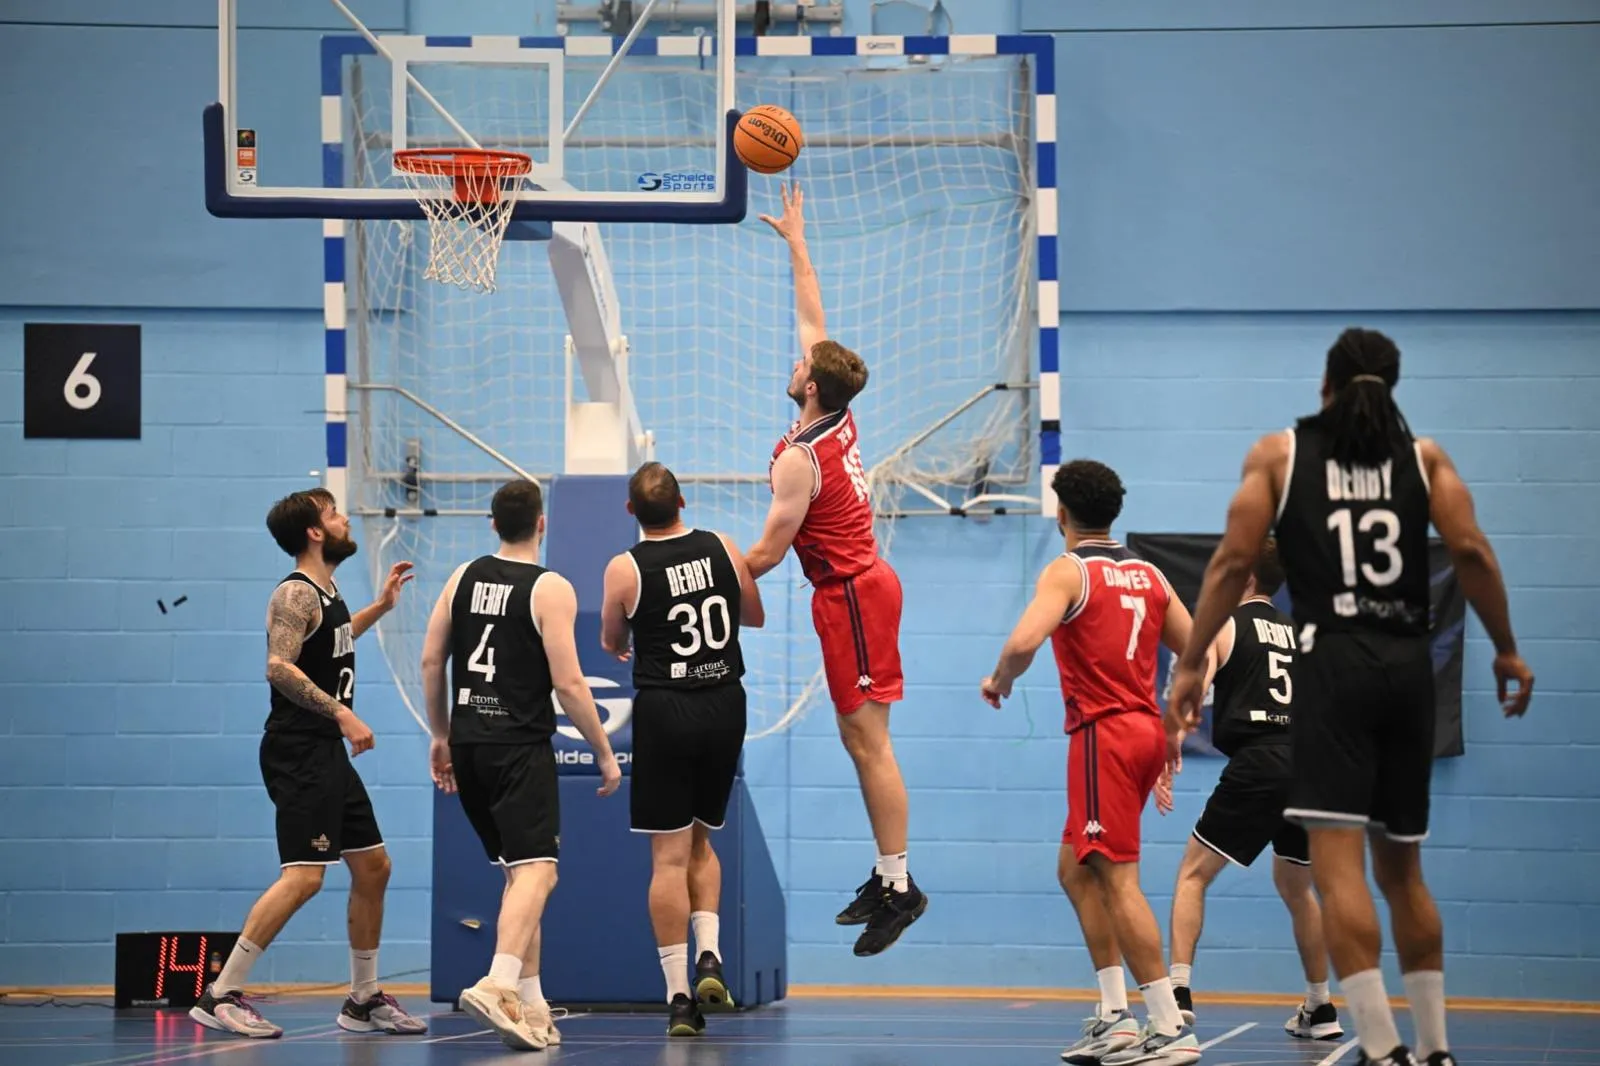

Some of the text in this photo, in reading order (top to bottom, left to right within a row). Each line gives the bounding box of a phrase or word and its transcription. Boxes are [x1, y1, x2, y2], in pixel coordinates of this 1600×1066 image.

[748, 117, 788, 148] Wilson
[663, 173, 715, 182] Schelde
[663, 182, 715, 191] Sports
[63, 352, 101, 410] 6
[1327, 508, 1403, 587] 13
[470, 581, 514, 616] DERBY
[665, 557, 714, 597] DERBY
[667, 595, 731, 656] 30
[1120, 594, 1146, 660] 7
[467, 624, 496, 682] 4
[688, 660, 725, 673] cartons
[1268, 651, 1292, 705] 5
[155, 936, 207, 998] 14
